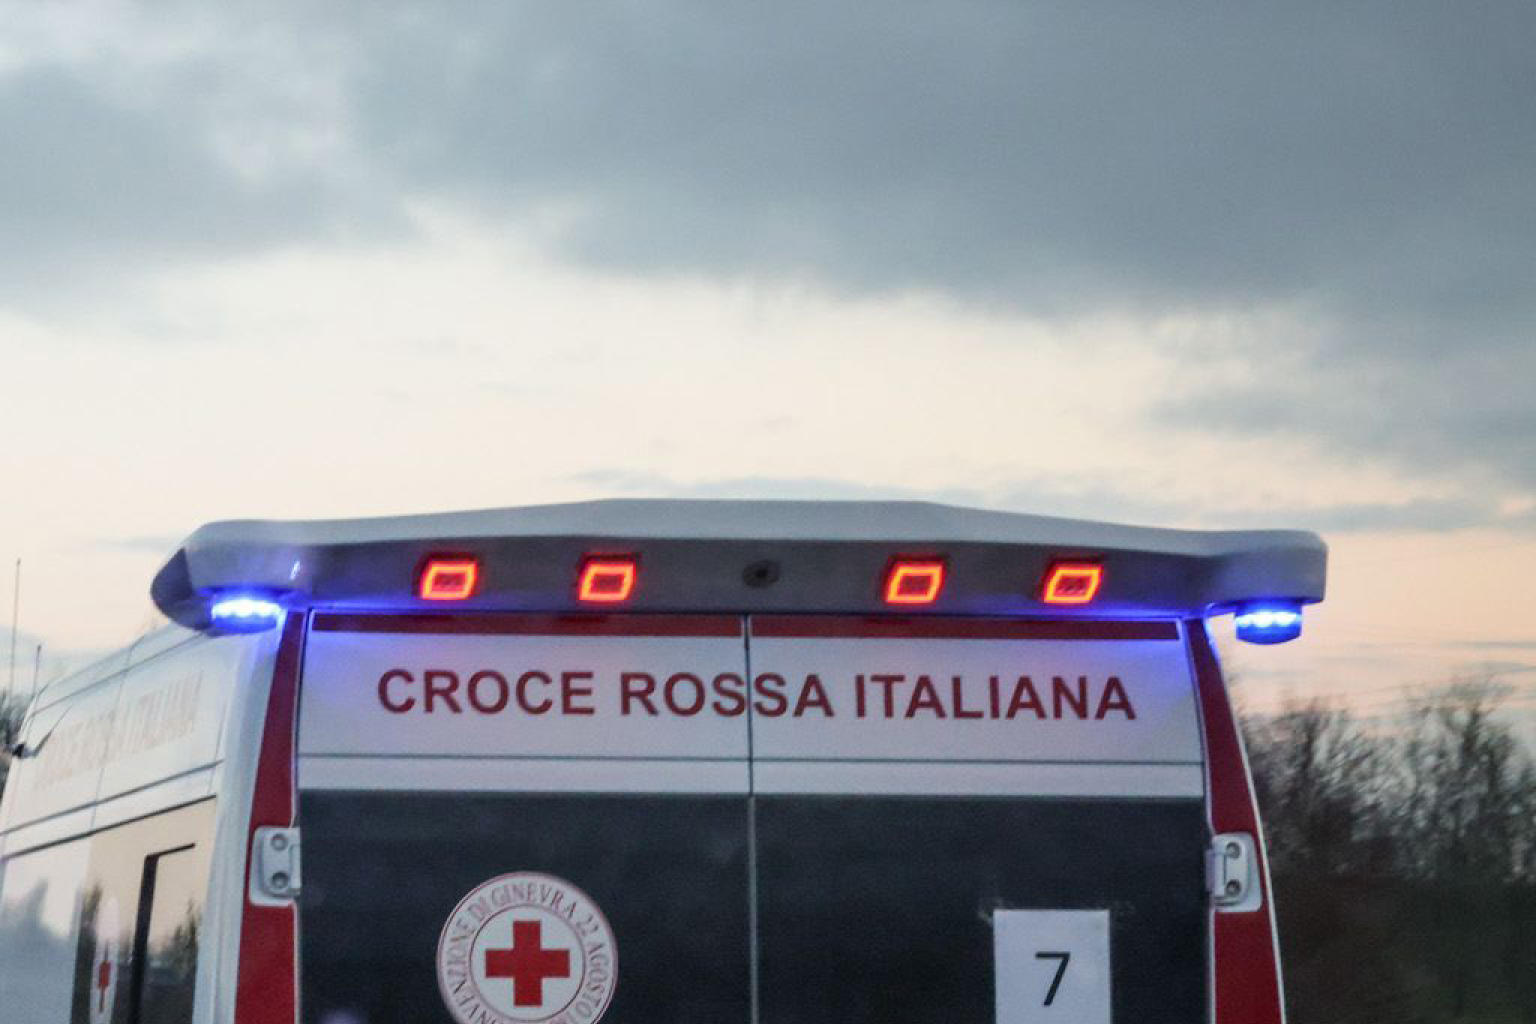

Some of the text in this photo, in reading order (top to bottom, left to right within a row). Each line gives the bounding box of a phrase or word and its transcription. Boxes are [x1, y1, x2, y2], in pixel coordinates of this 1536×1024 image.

[377, 668, 1137, 720] CROCE ROSSA ITALIANA
[491, 883, 577, 920] GINEVRA
[574, 943, 610, 1019] AGOSTO
[1034, 951, 1071, 1006] 7
